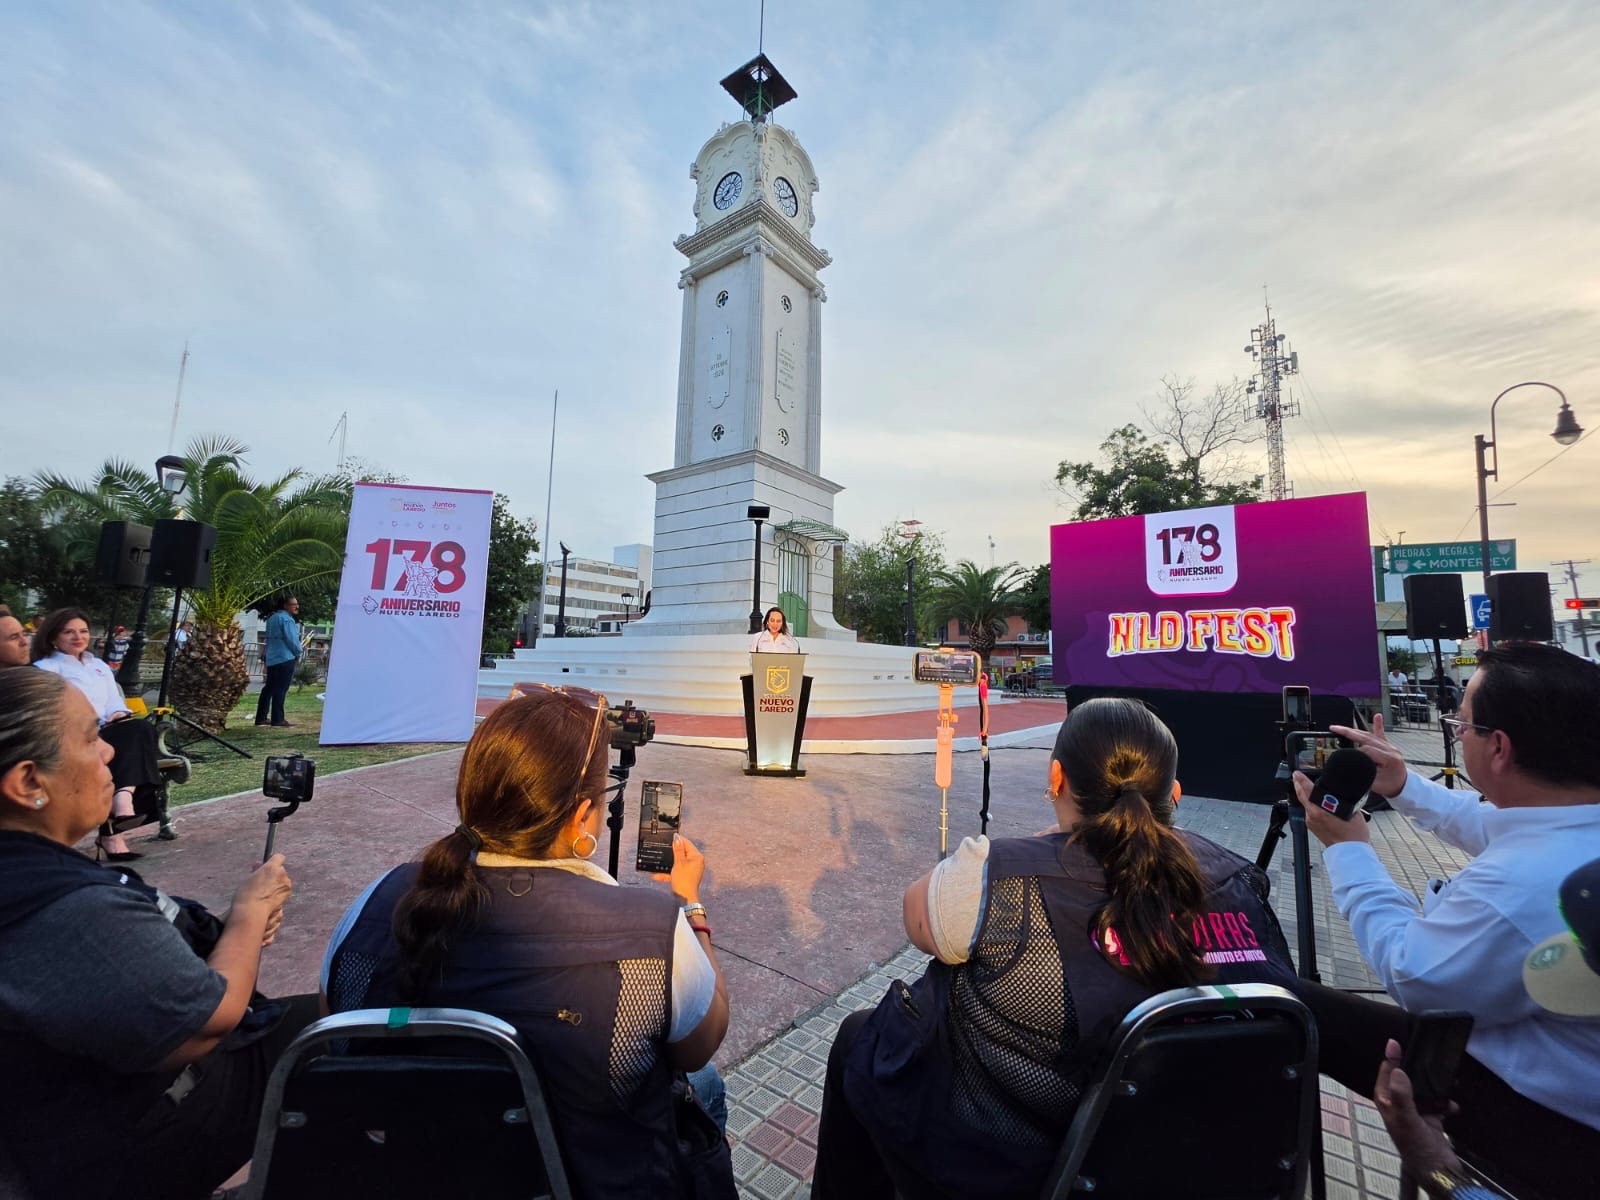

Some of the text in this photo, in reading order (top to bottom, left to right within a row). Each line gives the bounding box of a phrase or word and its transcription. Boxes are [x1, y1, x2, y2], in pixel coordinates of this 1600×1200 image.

[432, 501, 457, 509] Juntos
[1156, 523, 1222, 565] 178
[1393, 545, 1475, 558] PIEDRAS NEGRAS
[365, 538, 466, 594] 178
[1429, 556, 1512, 569] MONTEREY
[1169, 565, 1224, 577] ANIVERSARIO
[380, 597, 461, 612] ANIVERSARIO
[1185, 606, 1297, 661] FEST
[759, 698, 794, 706] NUEVO
